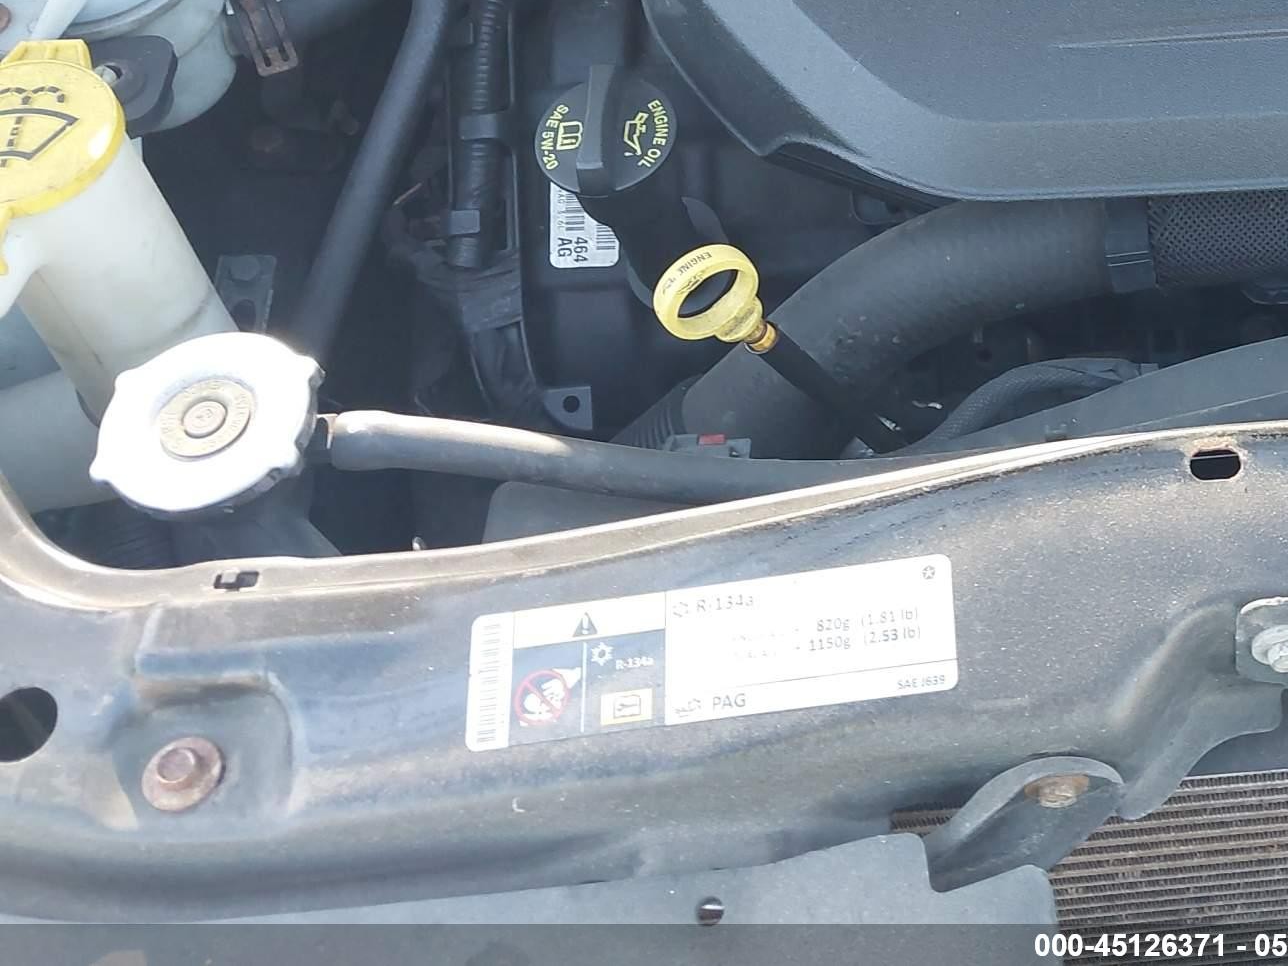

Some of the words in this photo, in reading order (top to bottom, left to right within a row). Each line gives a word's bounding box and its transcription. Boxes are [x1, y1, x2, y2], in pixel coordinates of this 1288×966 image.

[546, 104, 570, 129] SAE
[647, 99, 670, 147] ENGINE
[541, 130, 560, 170] 5W-20
[636, 148, 662, 168] OIL
[557, 236, 573, 258] AG
[573, 236, 588, 263] 464
[676, 251, 713, 276] ENGINE
[696, 594, 755, 613] R-134a
[815, 616, 850, 633] 820g
[860, 610, 895, 629] (1.81
[900, 607, 919, 624] lb)
[808, 636, 851, 653] 1150g
[863, 626, 899, 647] (2.53
[902, 625, 922, 642] lb)
[897, 677, 919, 690] SAE
[711, 692, 747, 710] PAG
